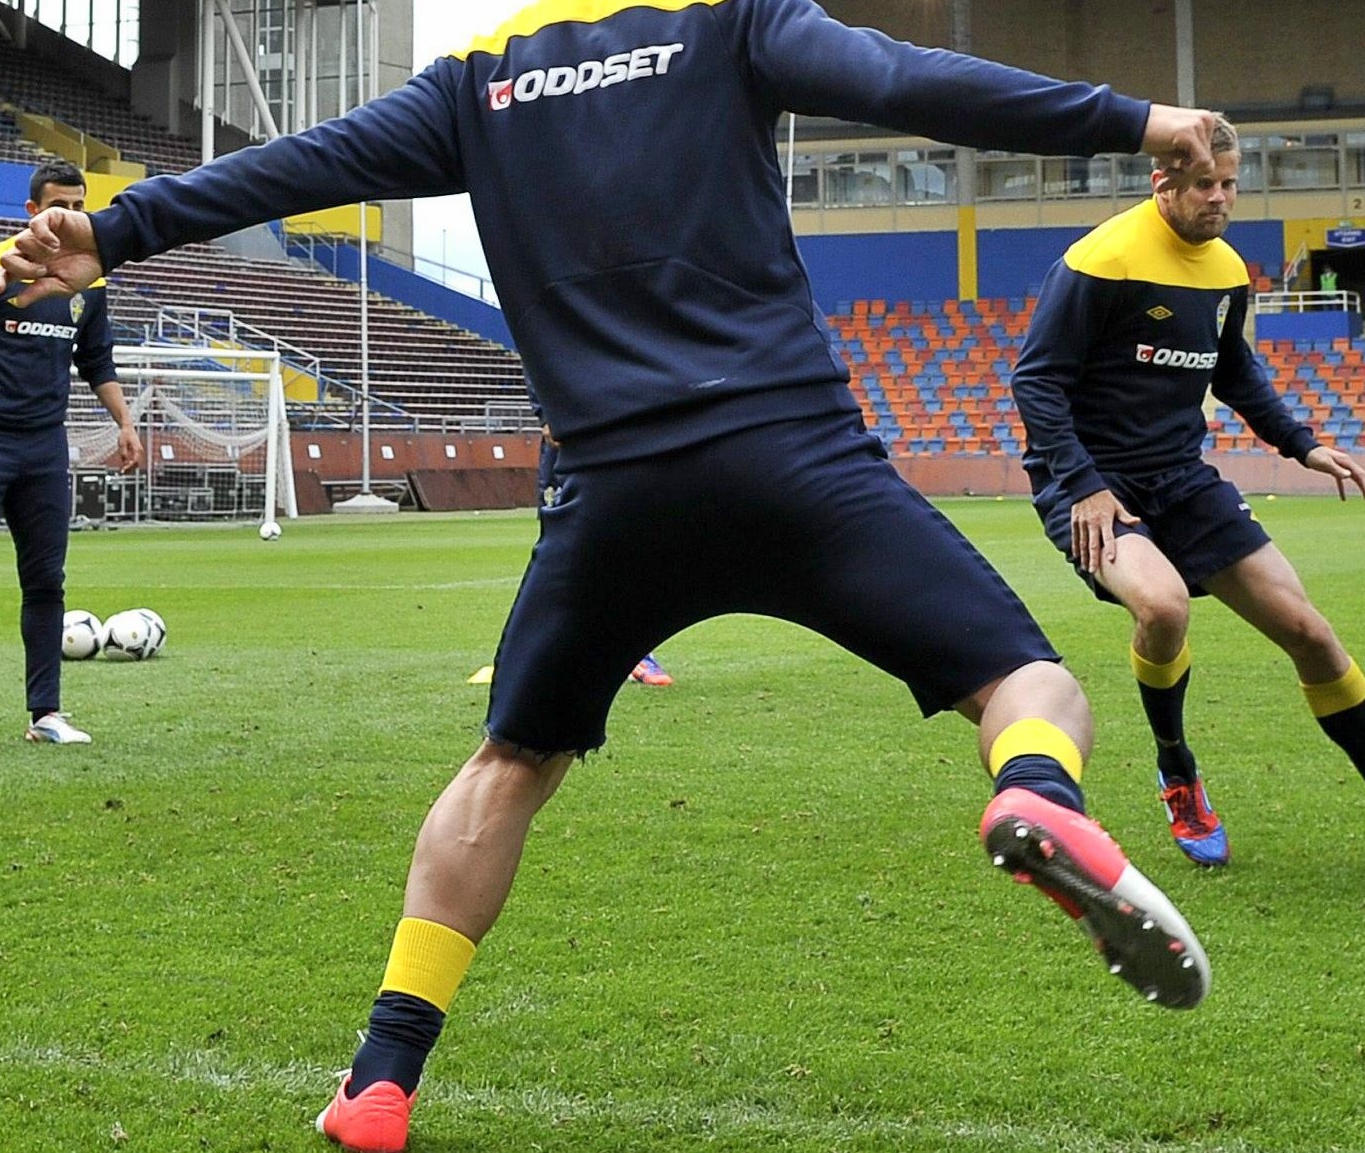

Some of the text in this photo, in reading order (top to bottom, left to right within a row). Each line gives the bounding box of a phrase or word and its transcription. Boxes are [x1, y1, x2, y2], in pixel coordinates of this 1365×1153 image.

[513, 43, 684, 103] ODDSET
[1353, 198, 1362, 210] 2
[17, 321, 78, 340] ODDSET
